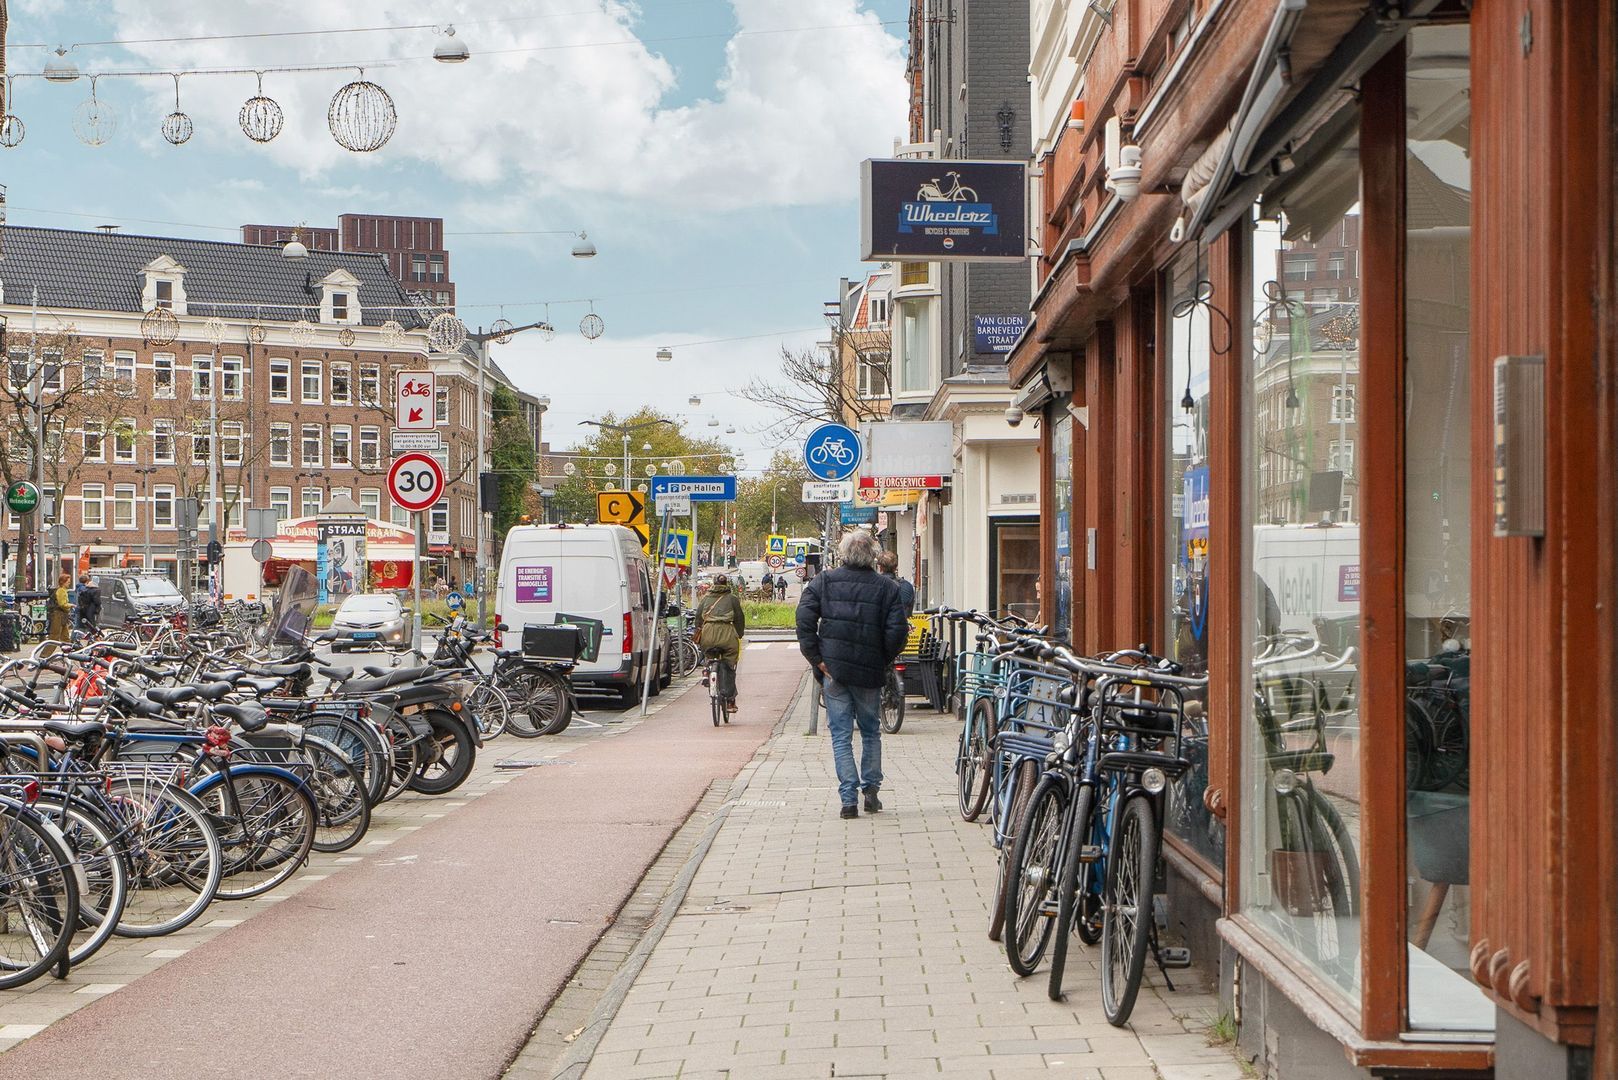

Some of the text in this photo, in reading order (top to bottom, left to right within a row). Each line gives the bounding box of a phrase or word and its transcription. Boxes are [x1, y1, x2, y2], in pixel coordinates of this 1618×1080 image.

[904, 204, 991, 223] Wheelerz
[979, 316, 995, 325] VAN
[977, 326, 1025, 335] BARNEVELDT
[987, 335, 1015, 344] STRAAT
[398, 470, 434, 493] 30
[681, 484, 721, 492] De Hallen
[9, 497, 36, 505] Heineken
[608, 500, 620, 516] C
